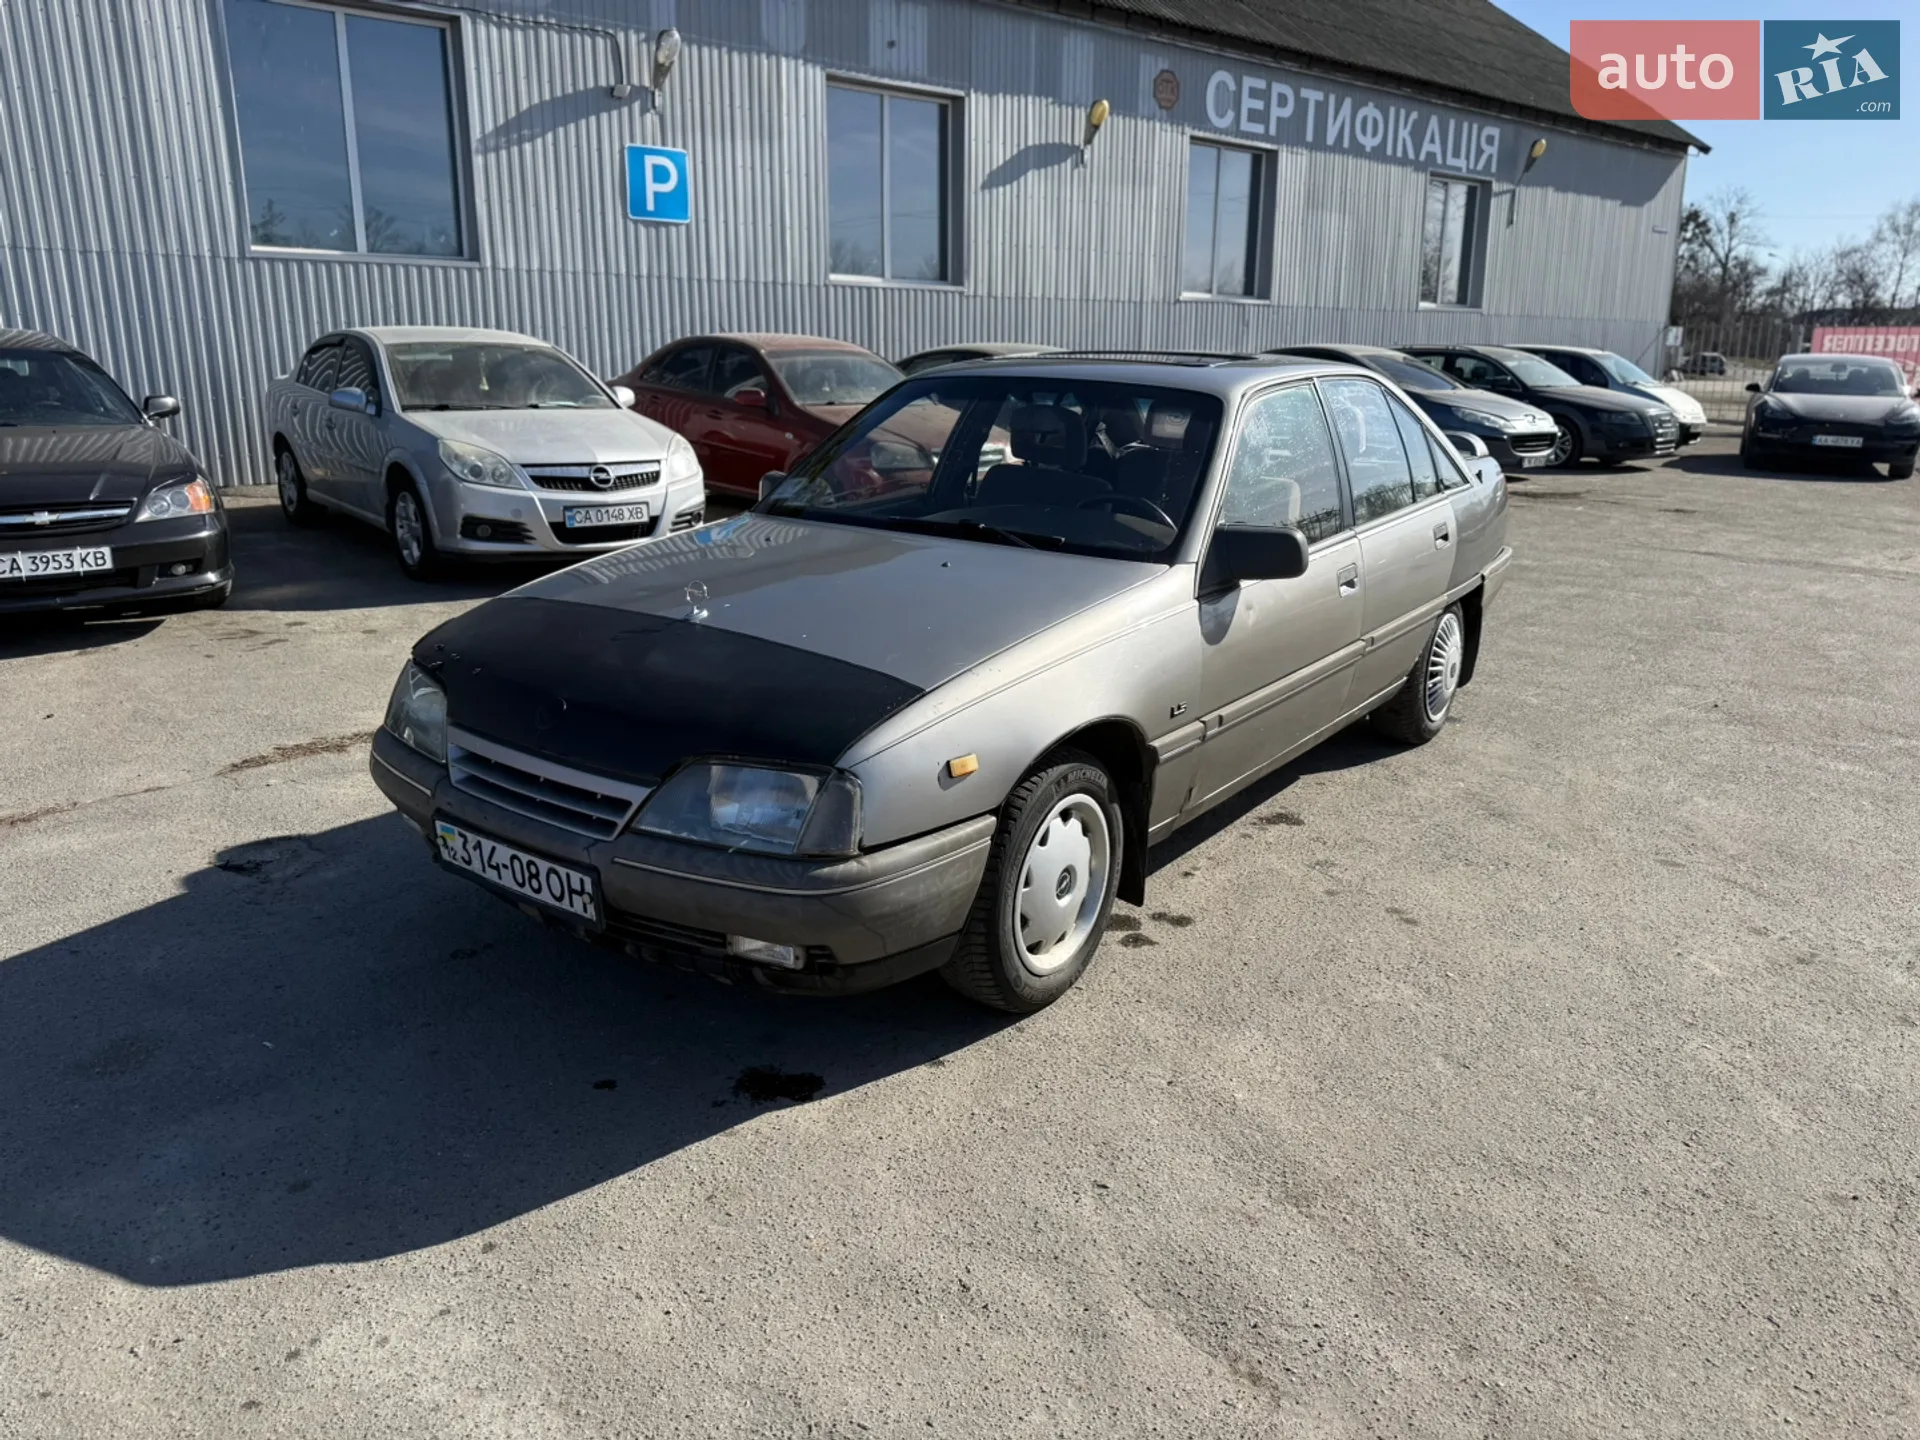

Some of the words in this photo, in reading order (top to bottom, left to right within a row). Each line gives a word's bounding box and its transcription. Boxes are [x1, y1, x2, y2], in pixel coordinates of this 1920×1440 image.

[1206, 69, 1500, 173] СЕРТИФІКАЦІЯ
[644, 155, 678, 211] P
[574, 510, 593, 524] CA
[596, 507, 625, 522] 0148
[627, 506, 644, 520] XB
[28, 553, 75, 572] 3953
[80, 550, 107, 569] KB
